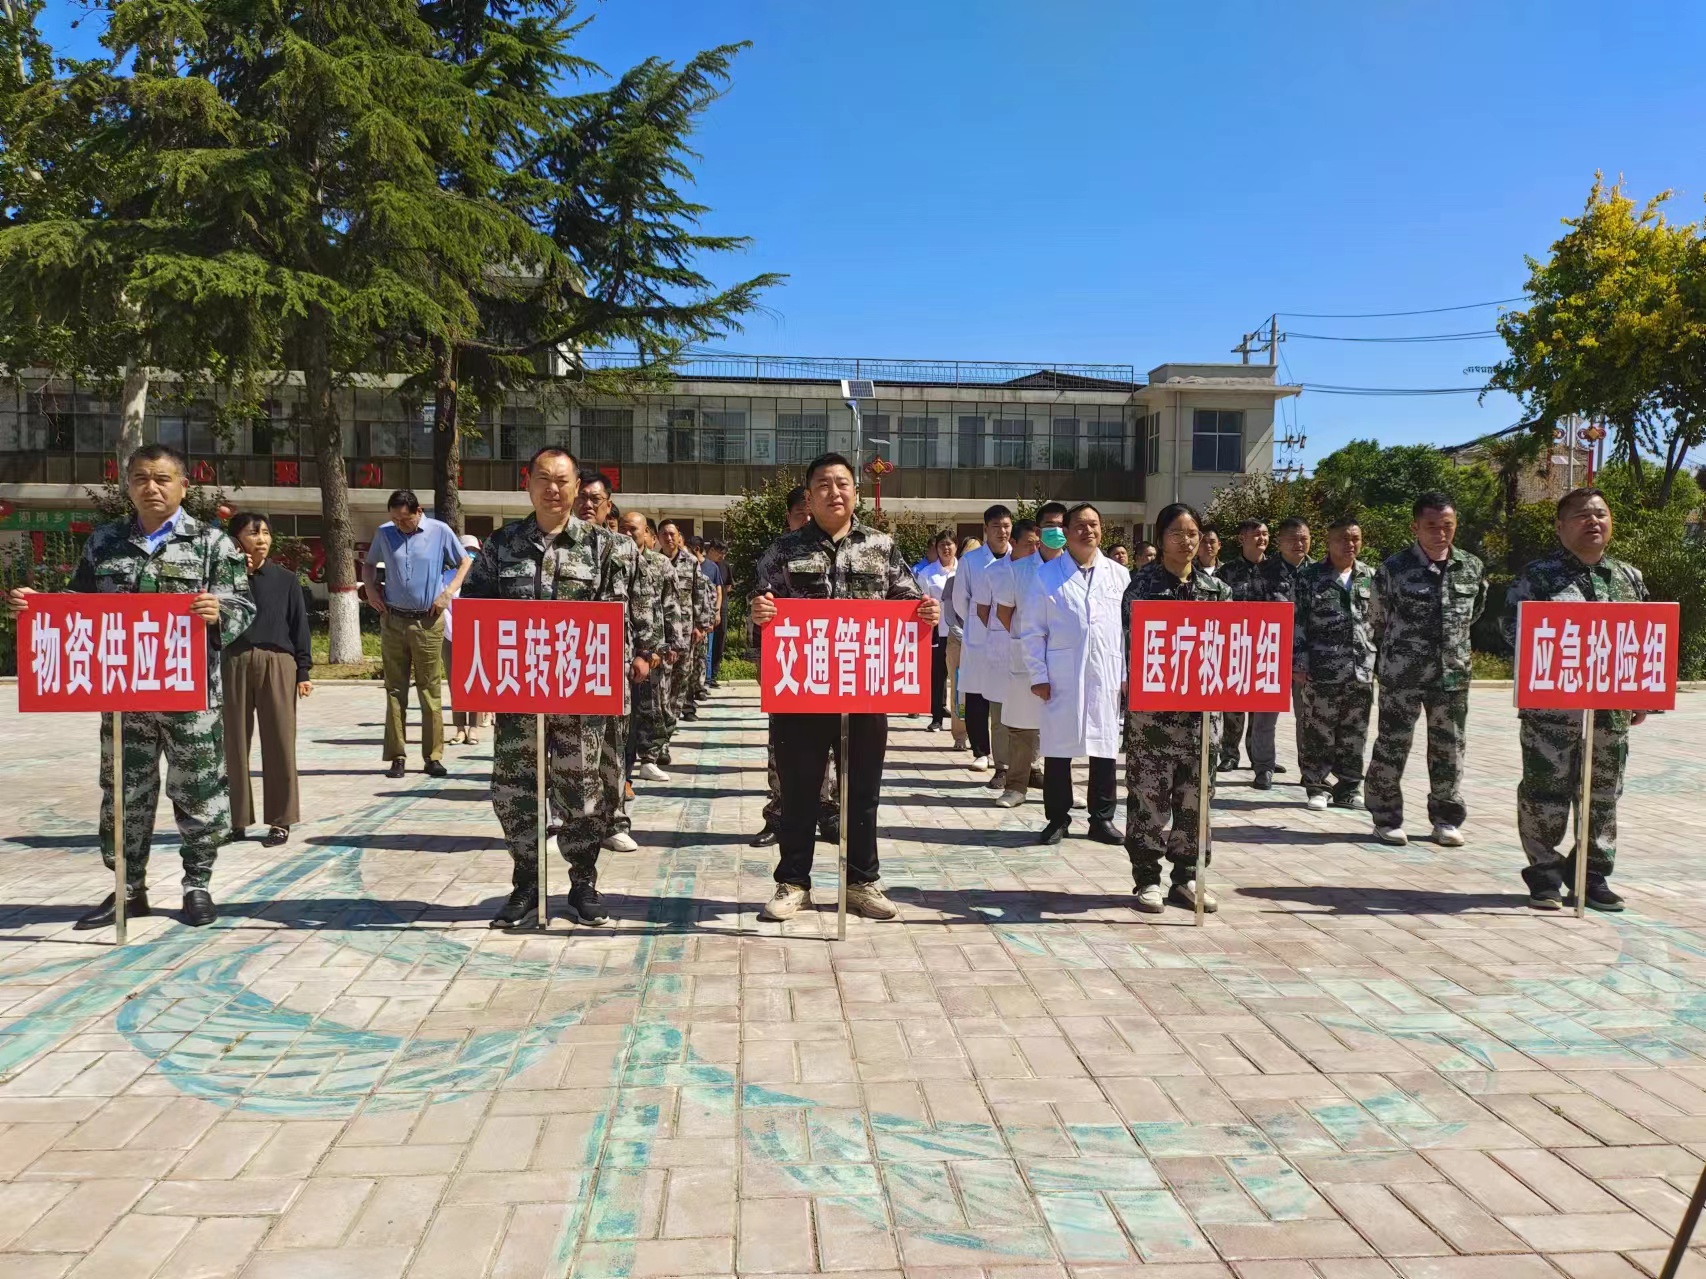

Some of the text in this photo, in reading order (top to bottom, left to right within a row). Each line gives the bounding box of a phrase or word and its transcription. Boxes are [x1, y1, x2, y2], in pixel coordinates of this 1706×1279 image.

[31, 610, 195, 696] 物资供应组
[464, 618, 612, 698] 人员转移组
[774, 616, 920, 697] 交通管制组
[1142, 618, 1281, 696] 医疗救助组
[1529, 617, 1666, 693] 应急抢险组
